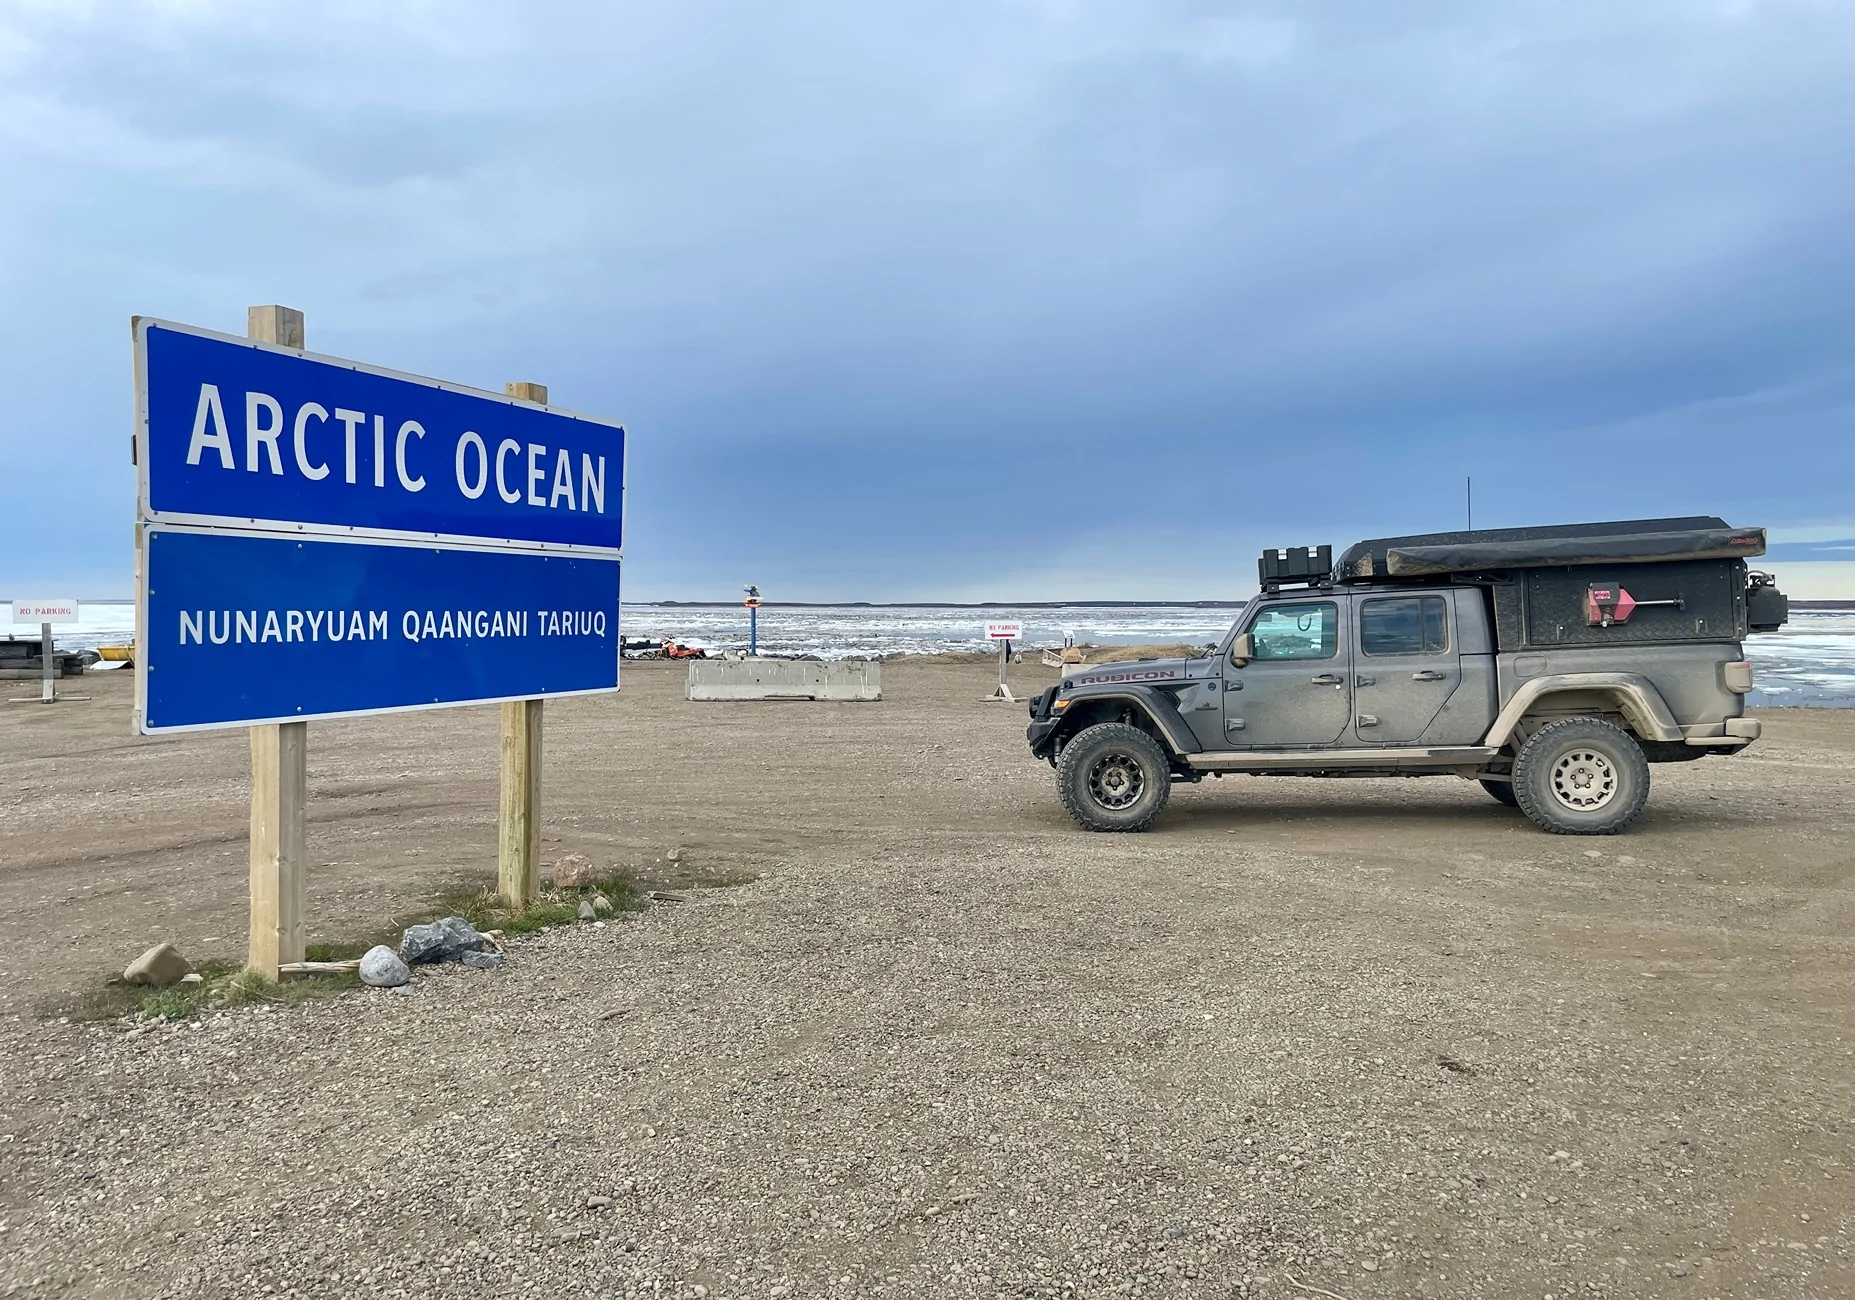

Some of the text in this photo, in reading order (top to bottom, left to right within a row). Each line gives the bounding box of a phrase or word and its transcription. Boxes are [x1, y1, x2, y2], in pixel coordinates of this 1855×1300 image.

[187, 383, 605, 514] ARCTIC OCEAN
[19, 607, 71, 615] NO PARKING
[179, 610, 606, 645] NUNARYUAM QAANGANI TARIUQ
[1081, 670, 1175, 684] RUBICON
